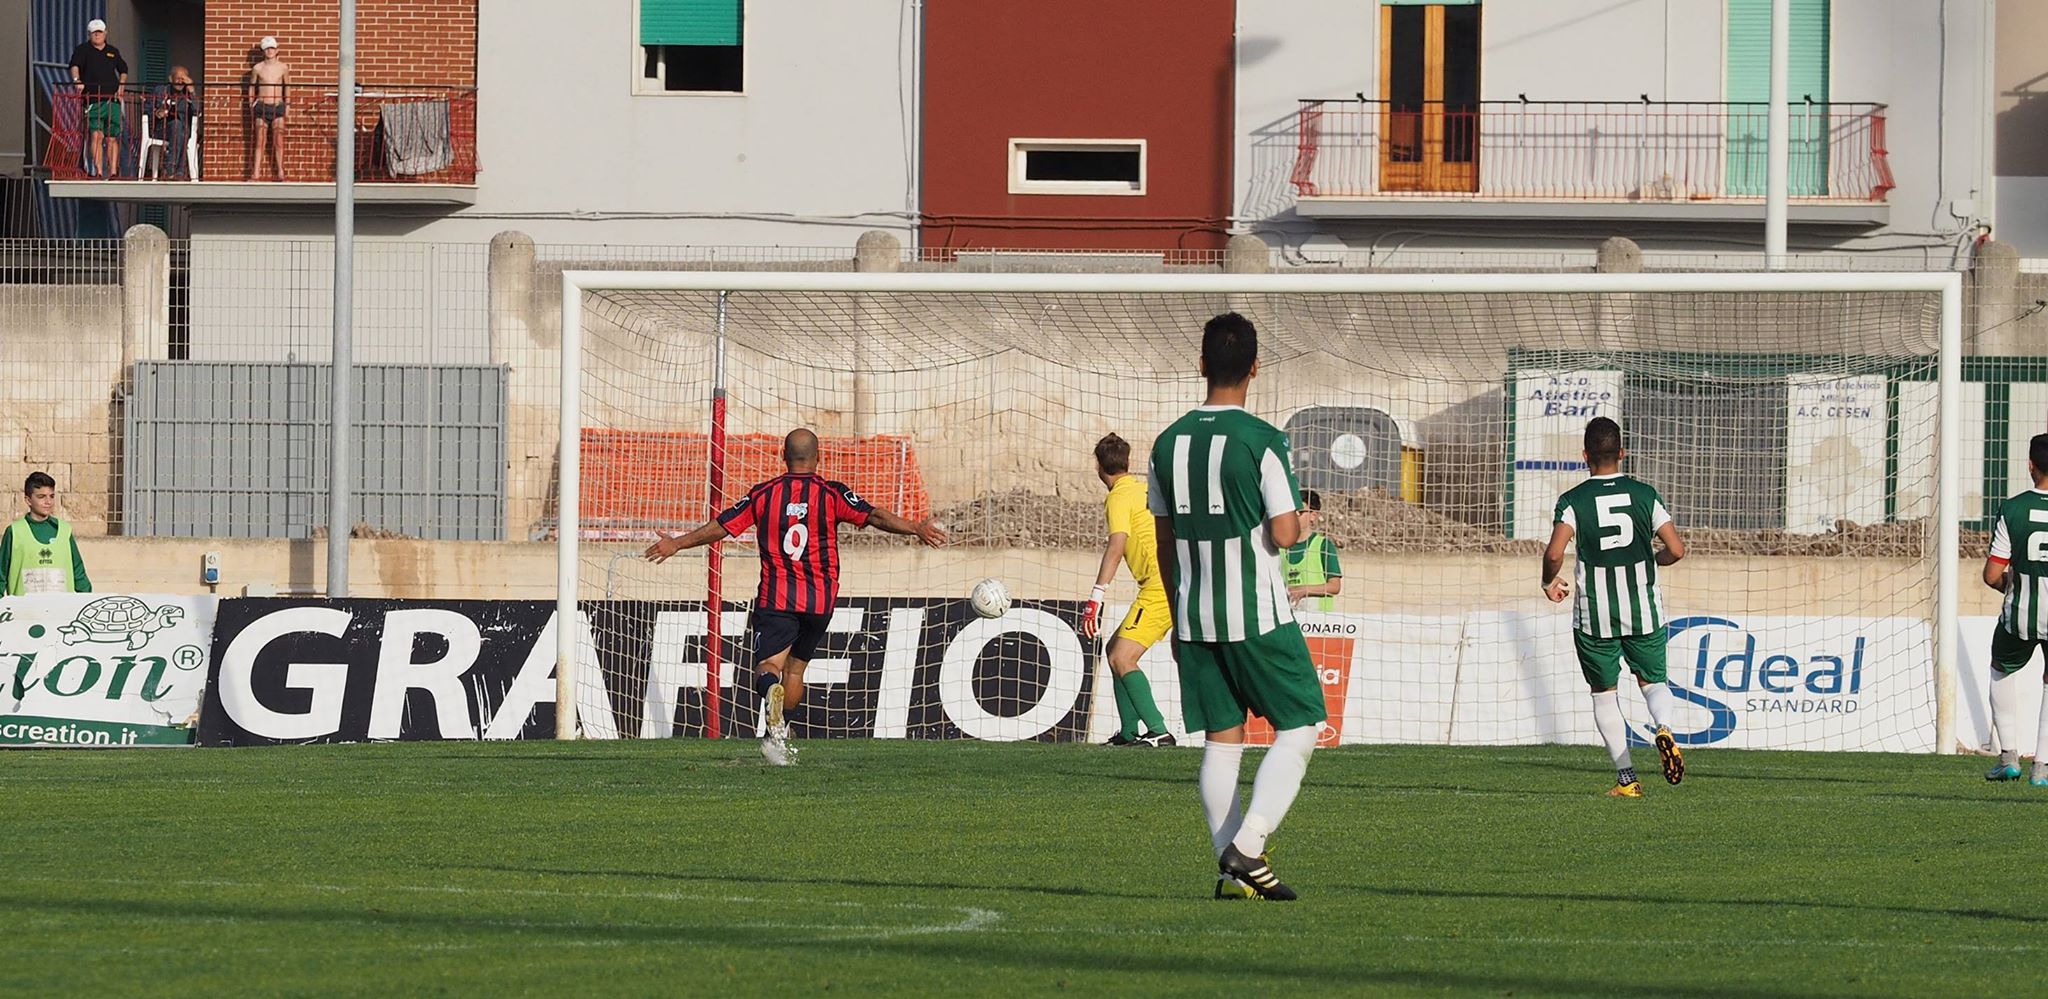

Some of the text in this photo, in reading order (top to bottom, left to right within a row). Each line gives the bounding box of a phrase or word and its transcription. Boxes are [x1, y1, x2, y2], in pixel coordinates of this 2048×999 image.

[1544, 401, 1598, 417] Bari
[1173, 435, 1228, 514] 11
[1595, 493, 1633, 551] 5
[783, 523, 808, 562] 9
[1694, 632, 1866, 695] Ideal
[1746, 698, 1858, 714] STANDARD
[0, 723, 138, 745] creation.it
